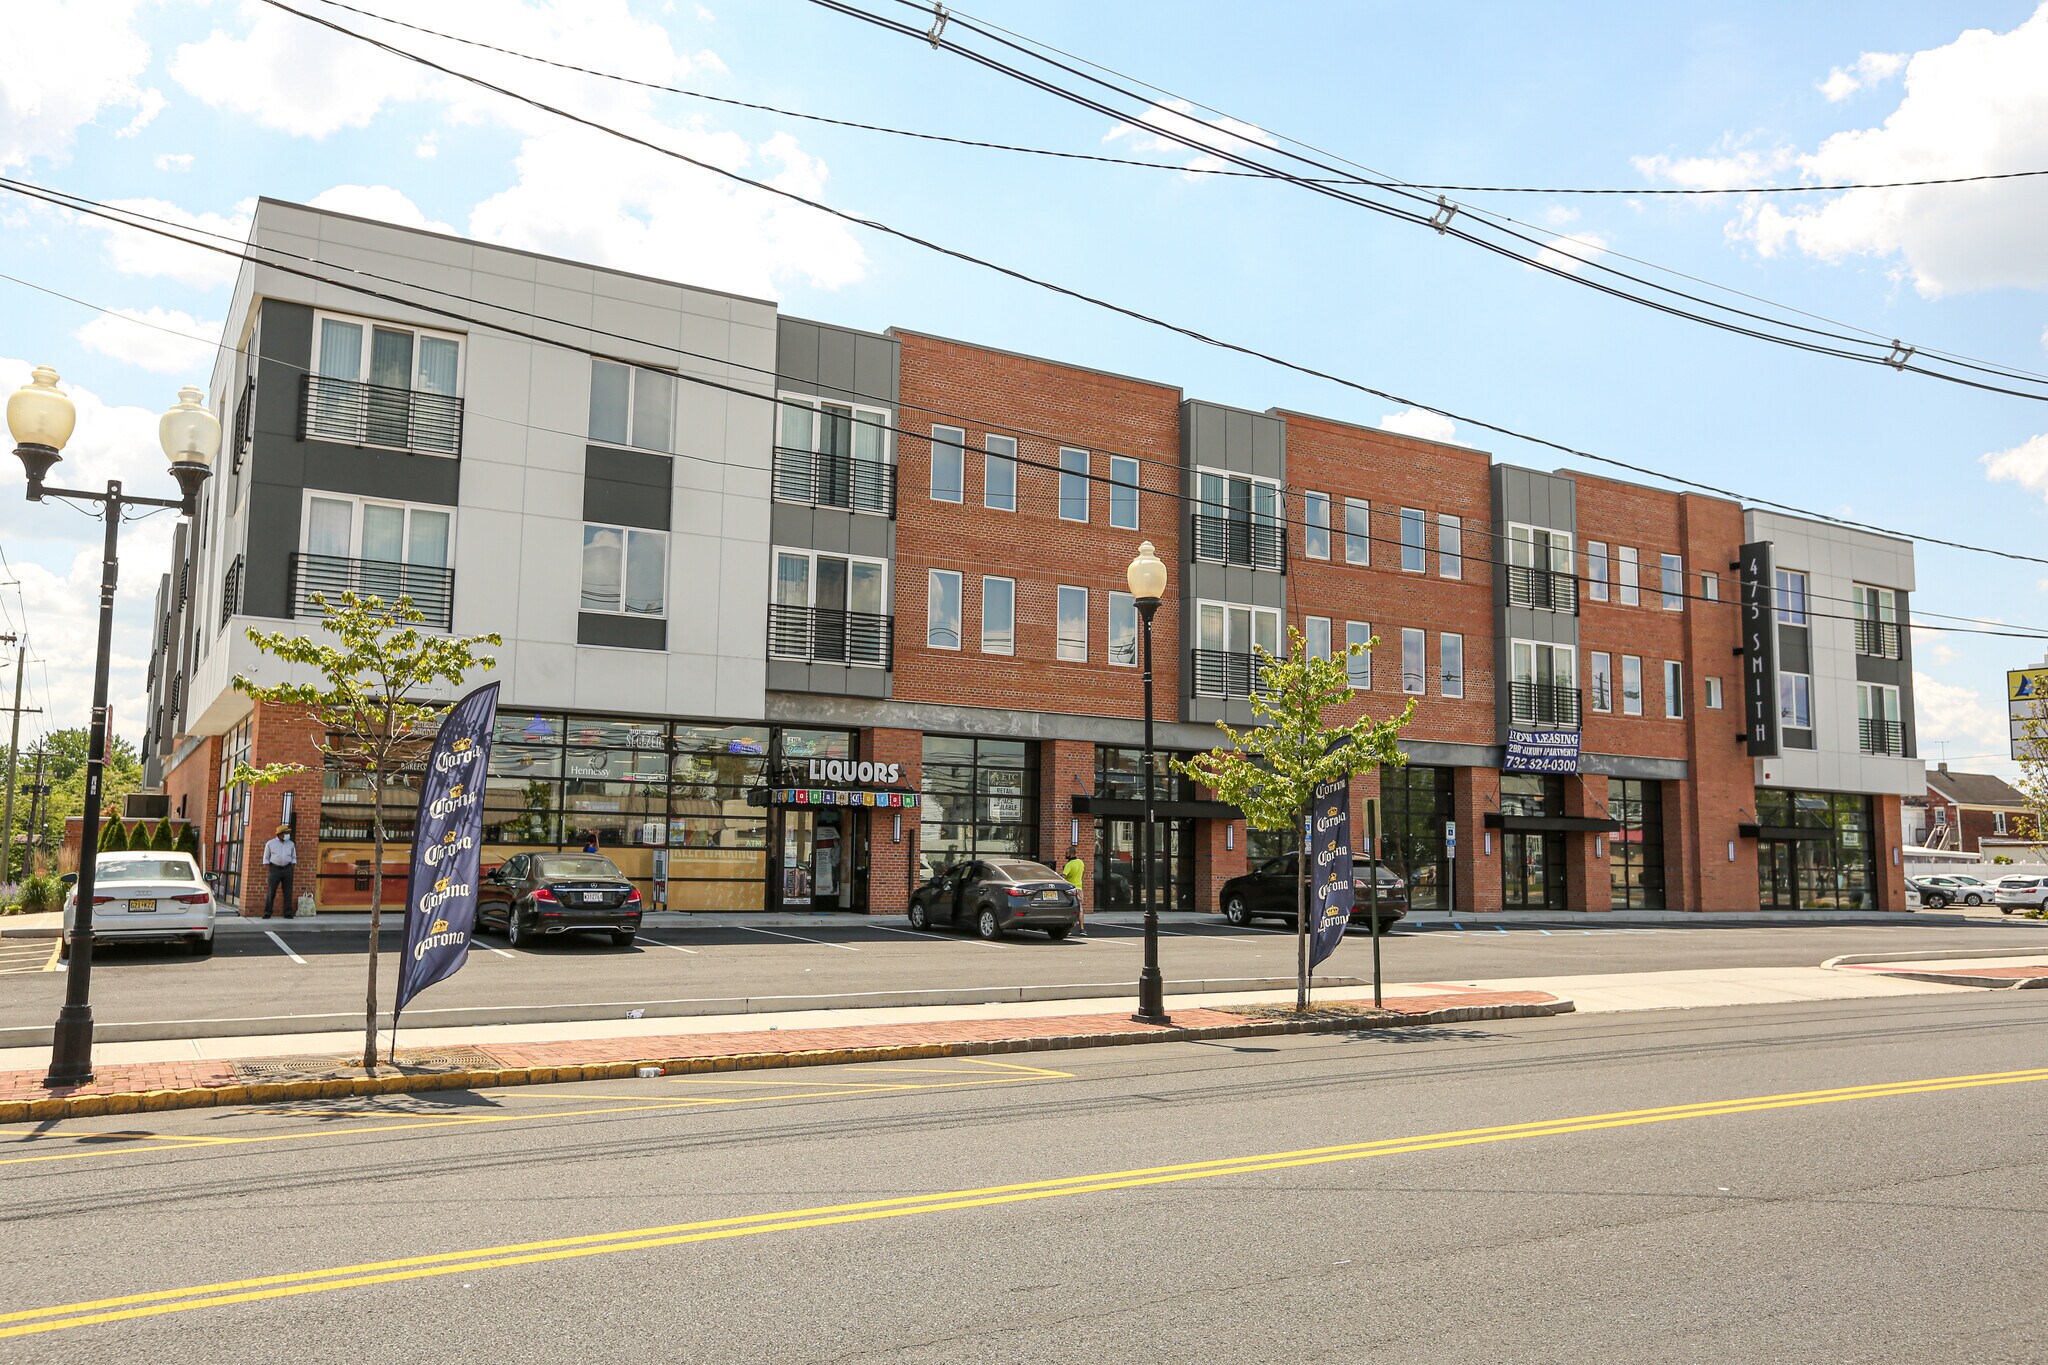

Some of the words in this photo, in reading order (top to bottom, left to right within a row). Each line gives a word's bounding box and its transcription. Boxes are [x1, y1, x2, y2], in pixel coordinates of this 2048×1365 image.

[1753, 633, 1766, 742] SMITH
[626, 734, 664, 749] SELTZER
[1509, 730, 1533, 742] NOW
[1535, 733, 1578, 745] LEASING
[435, 745, 482, 773] Coroa
[1506, 755, 1527, 769] 732
[1529, 758, 1576, 771] 324-0300
[571, 766, 610, 777] Hennessy
[809, 759, 899, 784] LIQUORS
[745, 839, 762, 847] ATM
[414, 931, 465, 960] Corona
